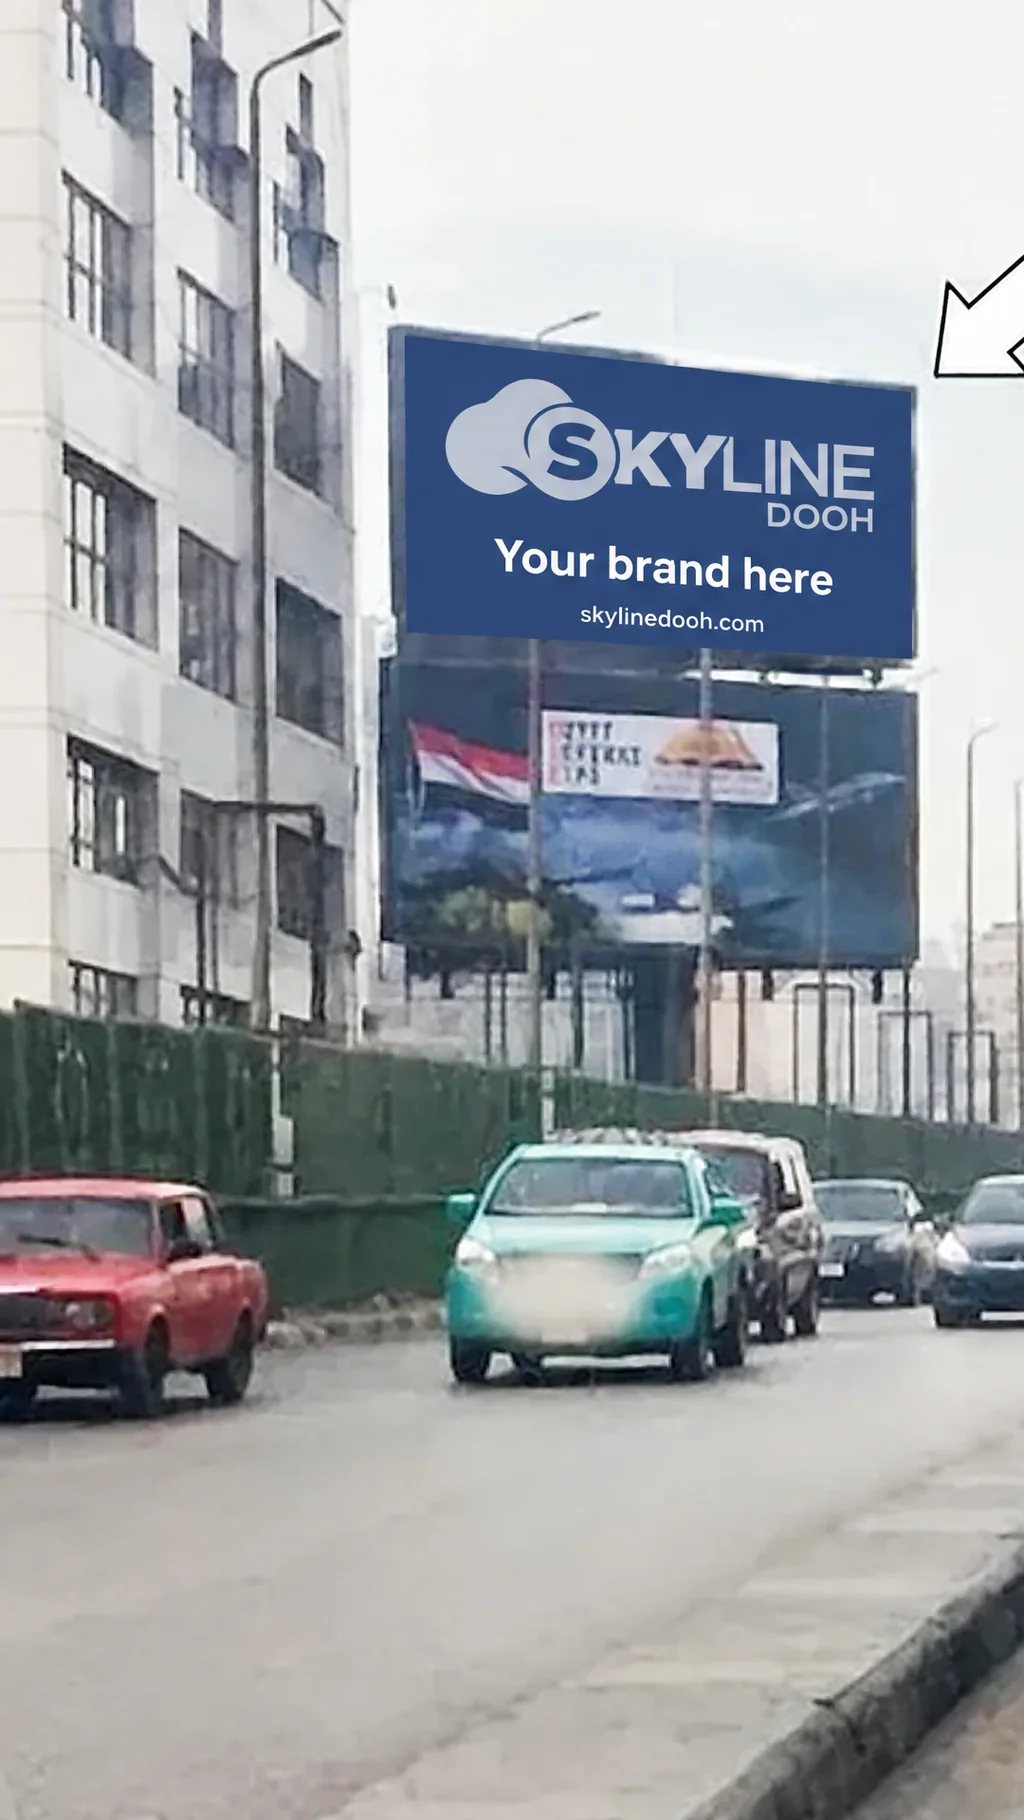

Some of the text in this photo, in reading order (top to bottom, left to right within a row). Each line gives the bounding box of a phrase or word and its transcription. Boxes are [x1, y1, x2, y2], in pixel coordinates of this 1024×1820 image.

[546, 421, 875, 501] SKYLINE
[767, 501, 874, 533] DOOH
[493, 537, 834, 596] Your brand here
[580, 605, 764, 633] skylinedooh.com
